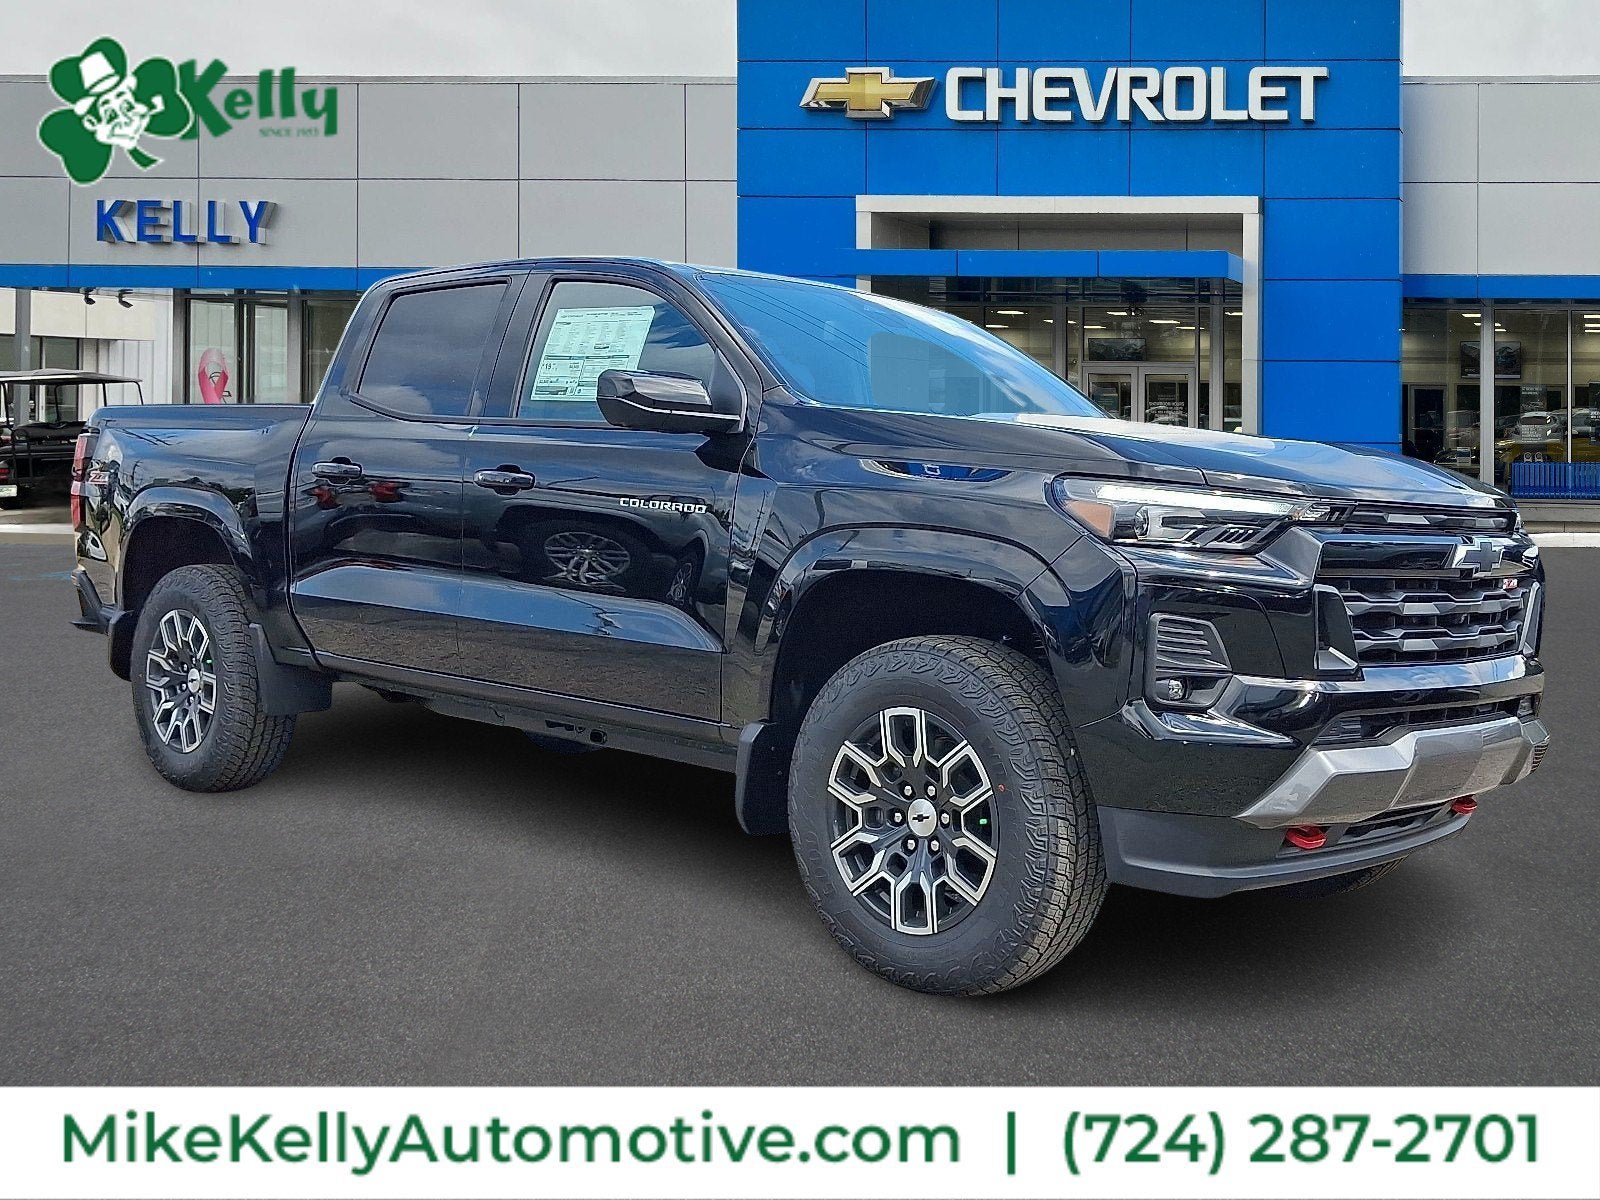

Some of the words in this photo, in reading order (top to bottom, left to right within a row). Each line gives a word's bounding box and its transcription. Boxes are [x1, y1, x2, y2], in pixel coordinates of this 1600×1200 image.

[945, 66, 1329, 122] CHEVROLET
[96, 200, 277, 244] KELLY
[619, 497, 707, 514] COLORADO
